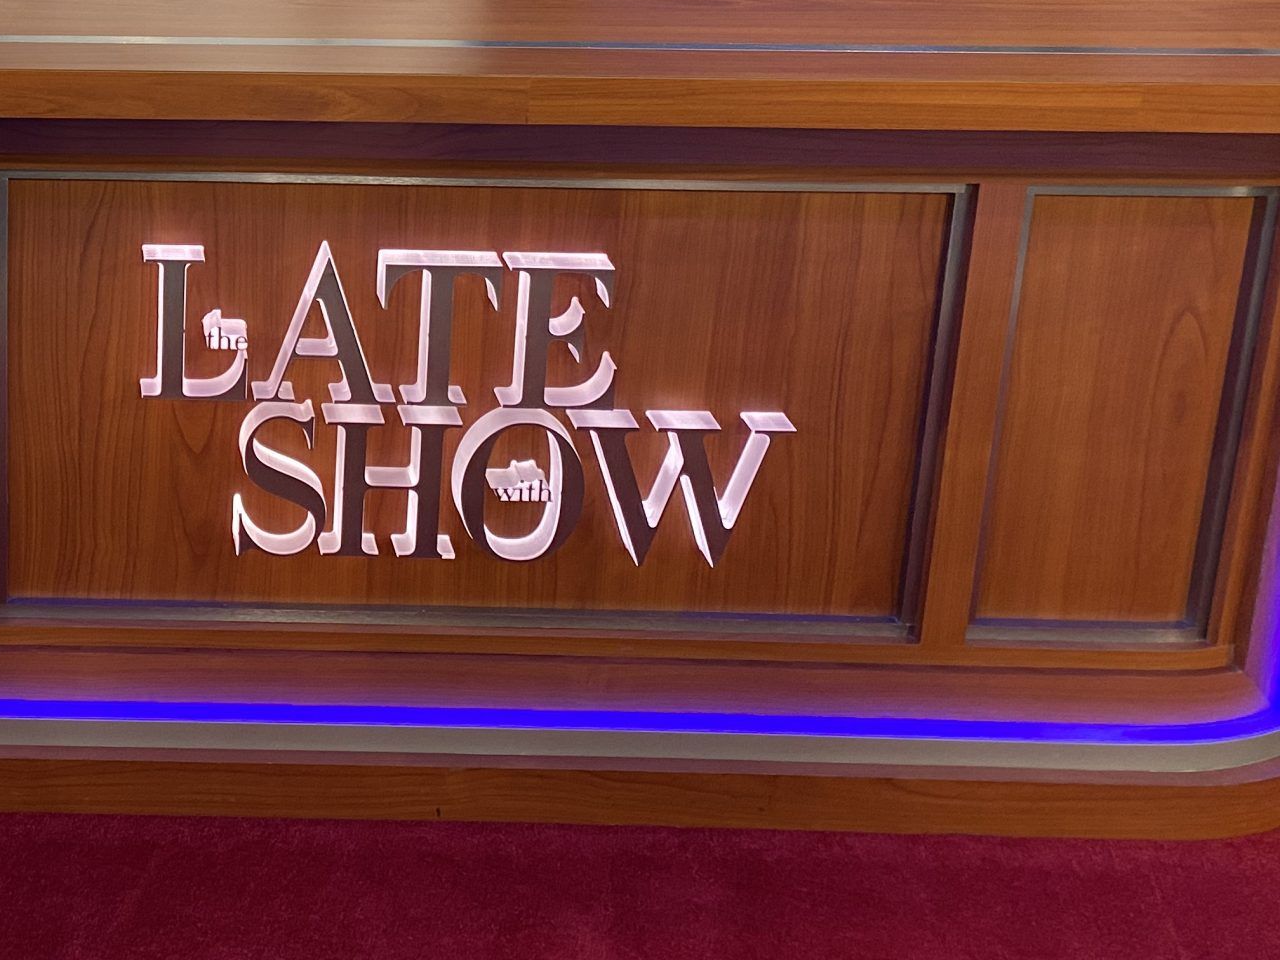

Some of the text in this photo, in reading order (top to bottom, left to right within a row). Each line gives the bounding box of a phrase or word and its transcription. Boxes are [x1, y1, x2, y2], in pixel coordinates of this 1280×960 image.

[139, 239, 616, 410] LATE
[206, 326, 249, 351] the
[232, 398, 797, 568] SHOW
[493, 479, 553, 503] with
